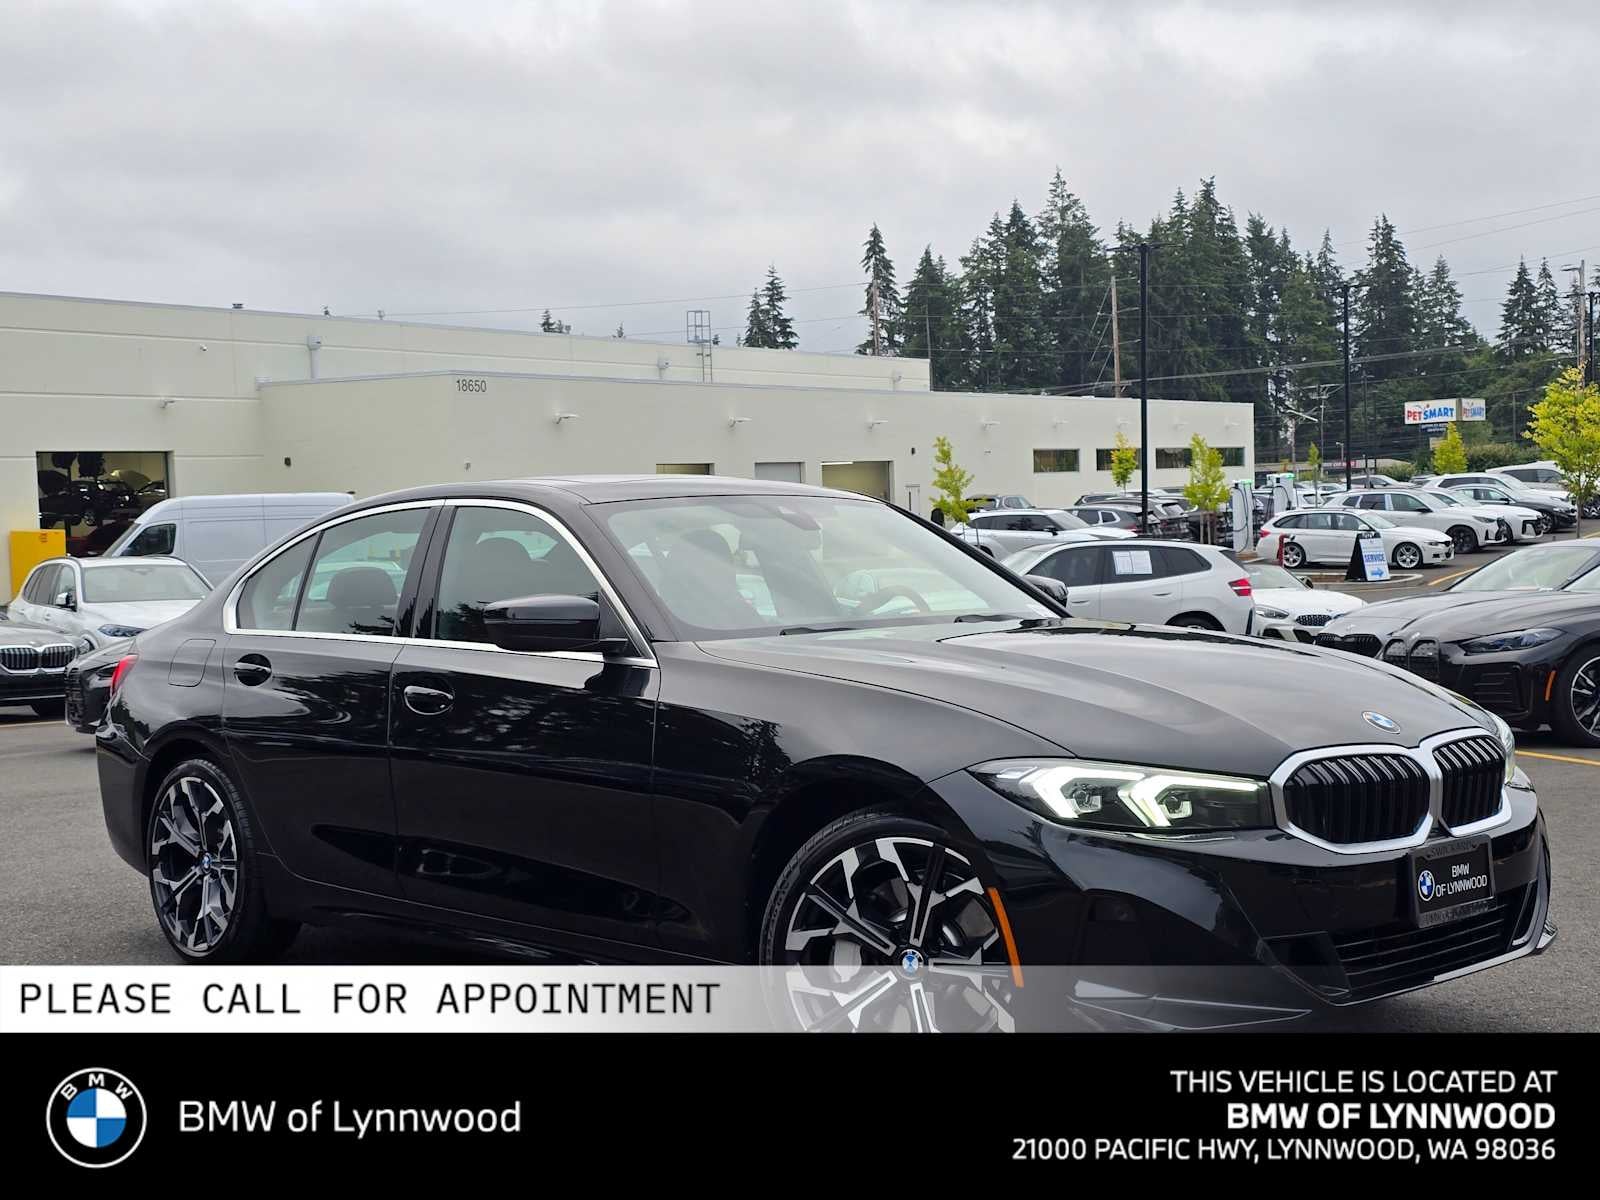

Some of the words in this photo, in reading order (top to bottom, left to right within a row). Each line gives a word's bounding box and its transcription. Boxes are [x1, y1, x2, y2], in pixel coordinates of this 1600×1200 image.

[456, 379, 487, 392] 18650
[1451, 863, 1470, 878] BMW
[1435, 883, 1447, 898] OF
[1447, 874, 1488, 895] LYNNWOOD
